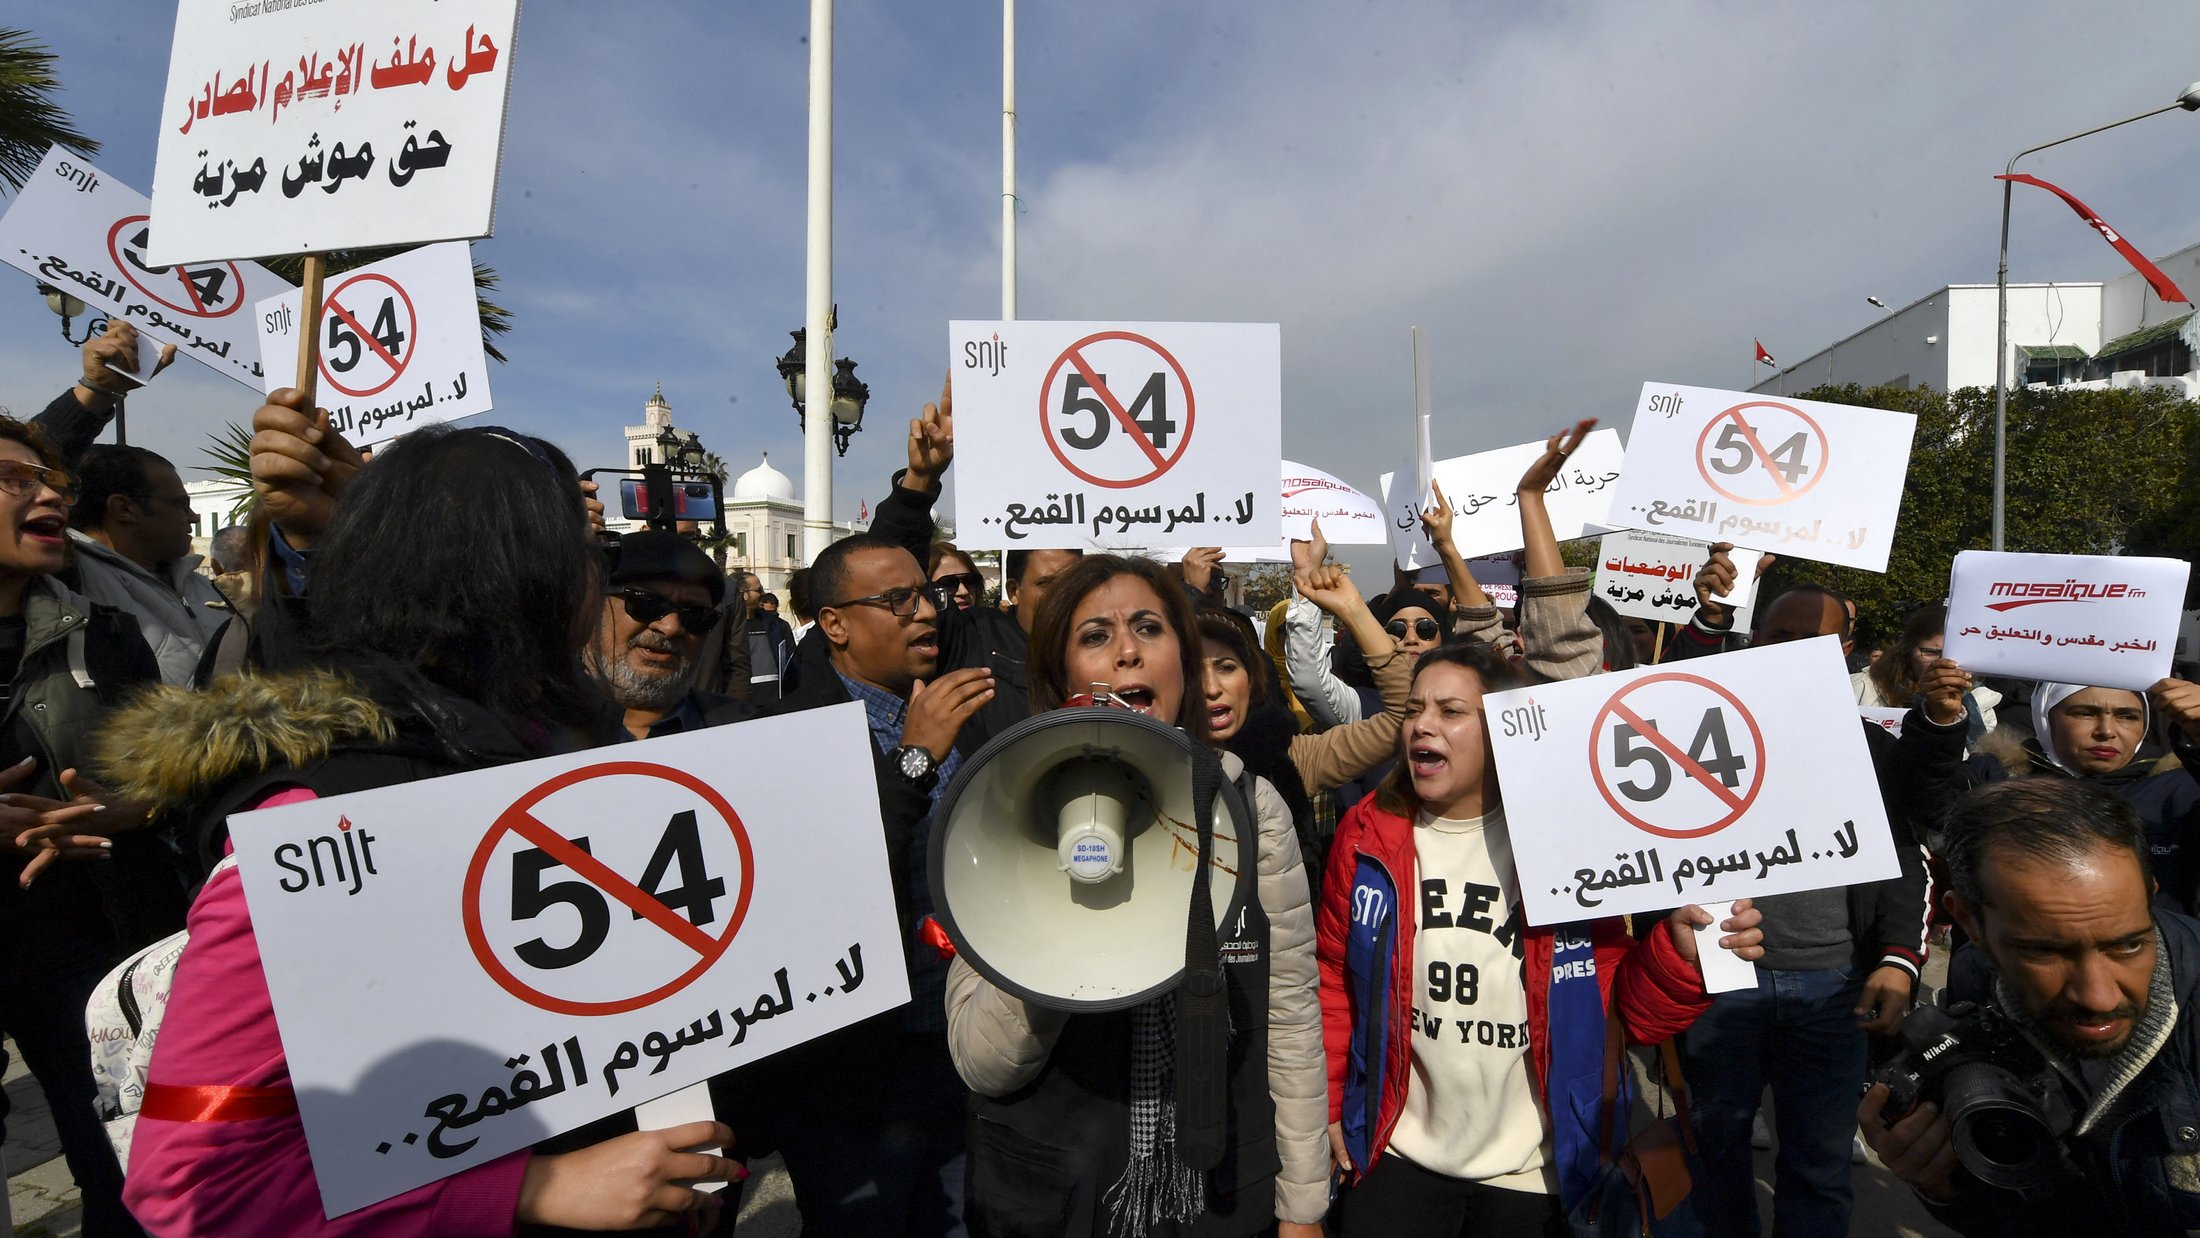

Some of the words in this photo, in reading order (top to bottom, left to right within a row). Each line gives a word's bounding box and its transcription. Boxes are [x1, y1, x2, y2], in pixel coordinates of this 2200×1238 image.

[229, 2, 261, 24] Syndicat
[371, 33, 437, 90] ملف
[447, 23, 499, 91] حل
[179, 59, 270, 136] المصادر
[272, 41, 365, 126] الإعلام
[281, 132, 376, 199] موش
[388, 119, 453, 187] حق
[55, 160, 101, 194] snjt
[193, 149, 268, 210] مزية
[124, 303, 232, 359] لمرسوم
[265, 301, 293, 336] snjt
[329, 296, 405, 374] 54
[965, 331, 1008, 377] snjt
[358, 381, 434, 438] لمرسوم
[1060, 372, 1177, 451] 54
[1648, 391, 1684, 419] snjt
[1710, 423, 1809, 485] 54
[1462, 492, 1498, 516] حق
[1573, 468, 1621, 494] حرية
[1093, 491, 1205, 538] لمرسوم
[1322, 508, 1349, 518] مقدس
[1351, 511, 1376, 520] الخبر
[1717, 514, 1823, 545] لمرسوم
[1605, 556, 1692, 582] الوضعيات
[1607, 580, 1645, 602] مزية
[1652, 587, 1698, 610] موش
[1960, 625, 1982, 636] حر
[1985, 625, 2053, 646] والتعليق
[2056, 634, 2105, 647] مقدس
[2108, 639, 2157, 654] الخبر
[1501, 696, 1548, 742] snjt
[1613, 706, 1747, 803] 54
[273, 813, 378, 896] snjt
[1073, 855, 1109, 863] MEGAPHONE
[1672, 828, 1803, 896] لمرسوم
[510, 808, 727, 971] 54
[1428, 960, 1479, 1006] 98
[602, 966, 795, 1098] لمرسوم
[1411, 1006, 1443, 1041] EW
[1456, 1020, 1529, 1049] YORK
[1922, 1037, 1953, 1061] Nikon
